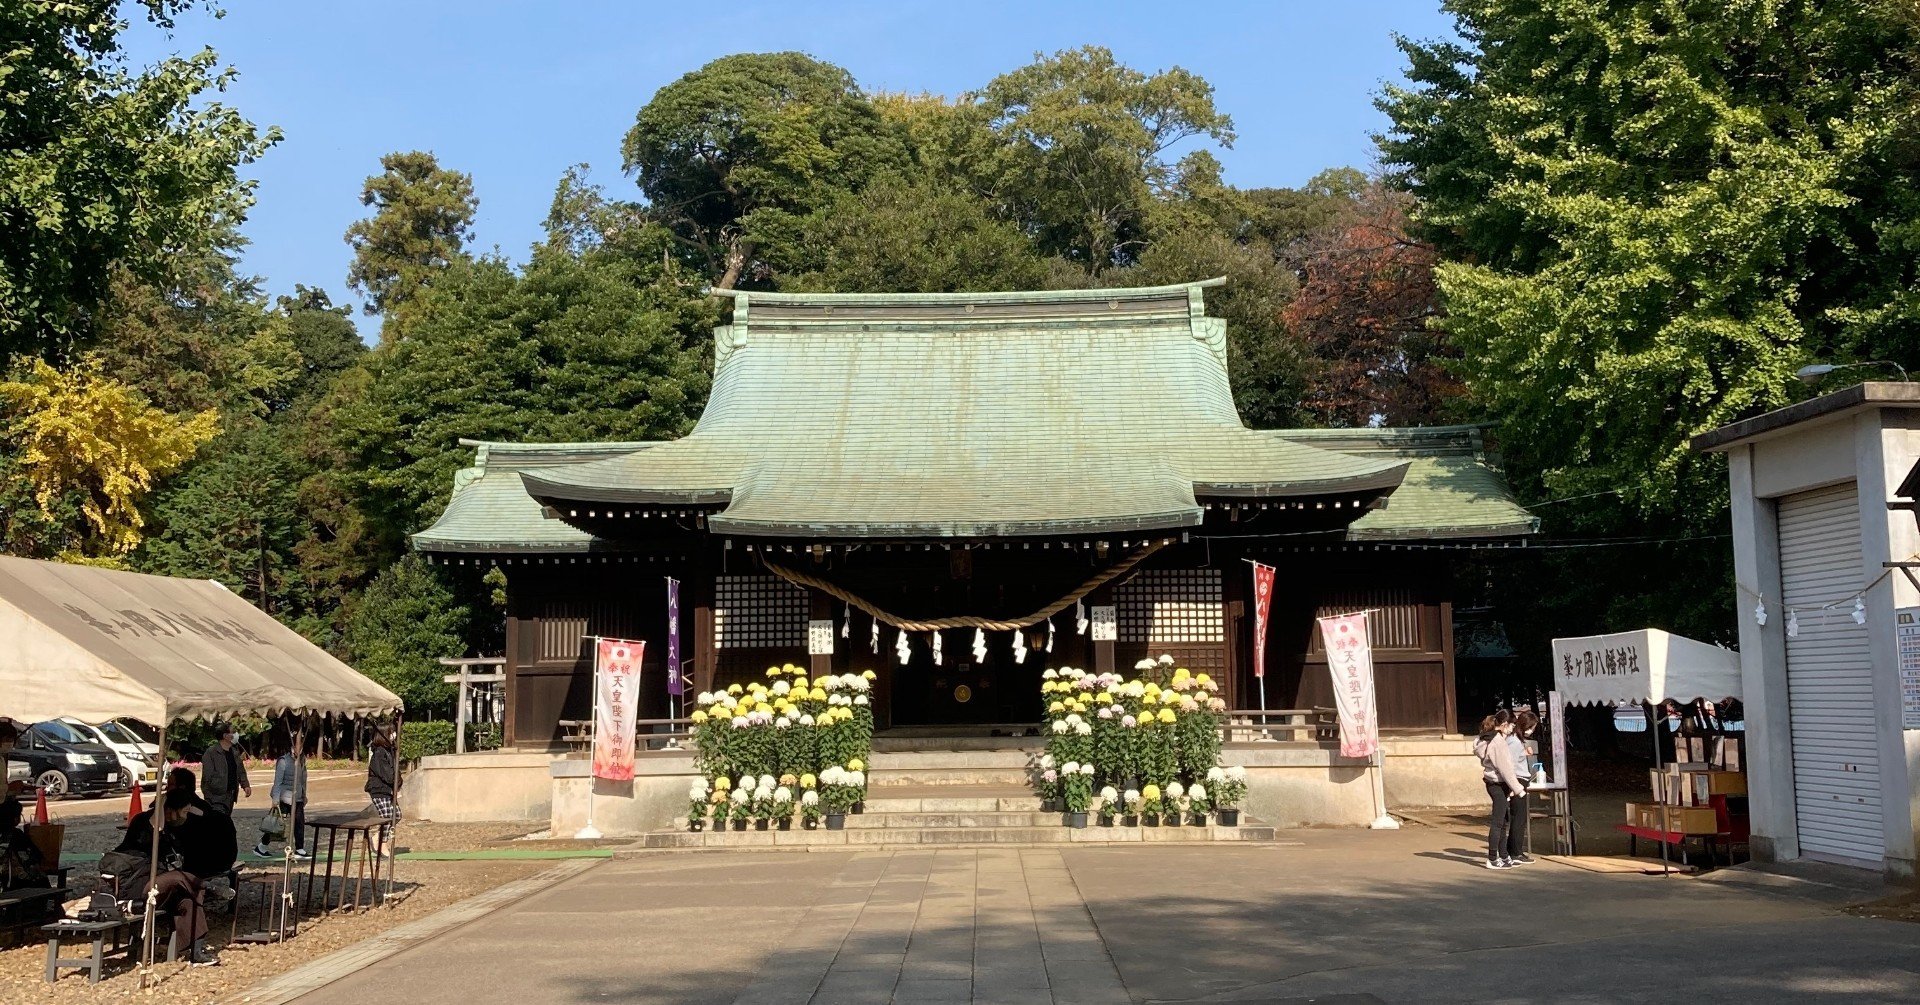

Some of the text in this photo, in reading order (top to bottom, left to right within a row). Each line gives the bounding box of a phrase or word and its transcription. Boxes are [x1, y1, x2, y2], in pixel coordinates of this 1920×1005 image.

[608, 662, 631, 675] 奉祝
[609, 675, 624, 778] 天皇陛下御即位
